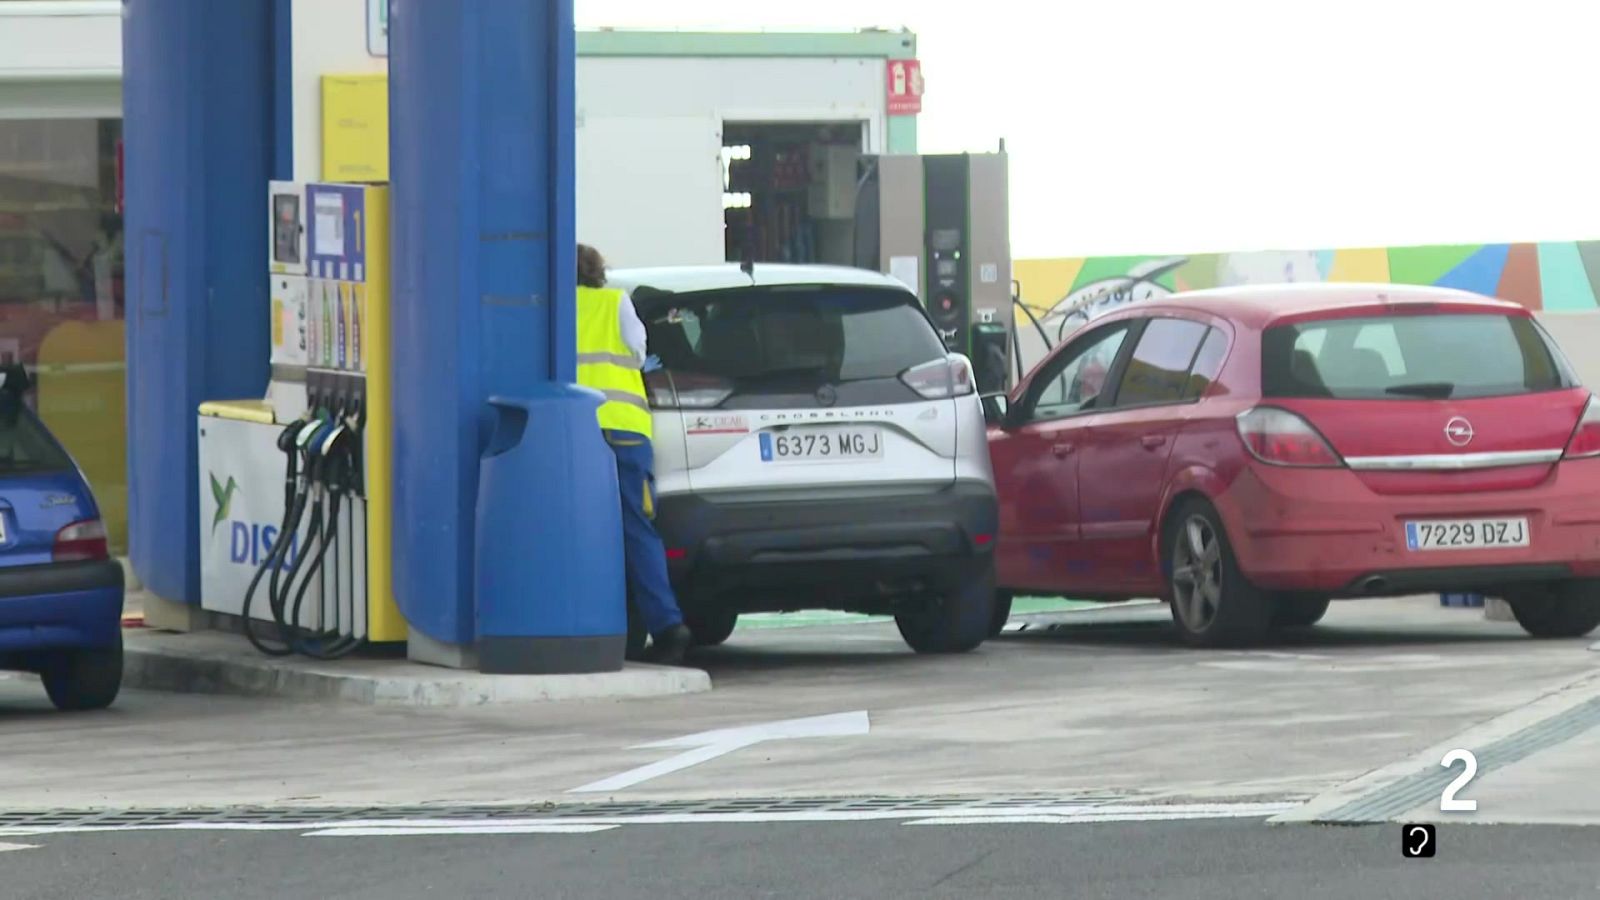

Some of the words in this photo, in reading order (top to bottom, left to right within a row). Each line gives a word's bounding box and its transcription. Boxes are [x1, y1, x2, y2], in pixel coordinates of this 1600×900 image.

[776, 434, 831, 457] 6373
[839, 433, 879, 455] MGJ
[1420, 523, 1475, 546] 7229
[1482, 521, 1524, 544] DZJ
